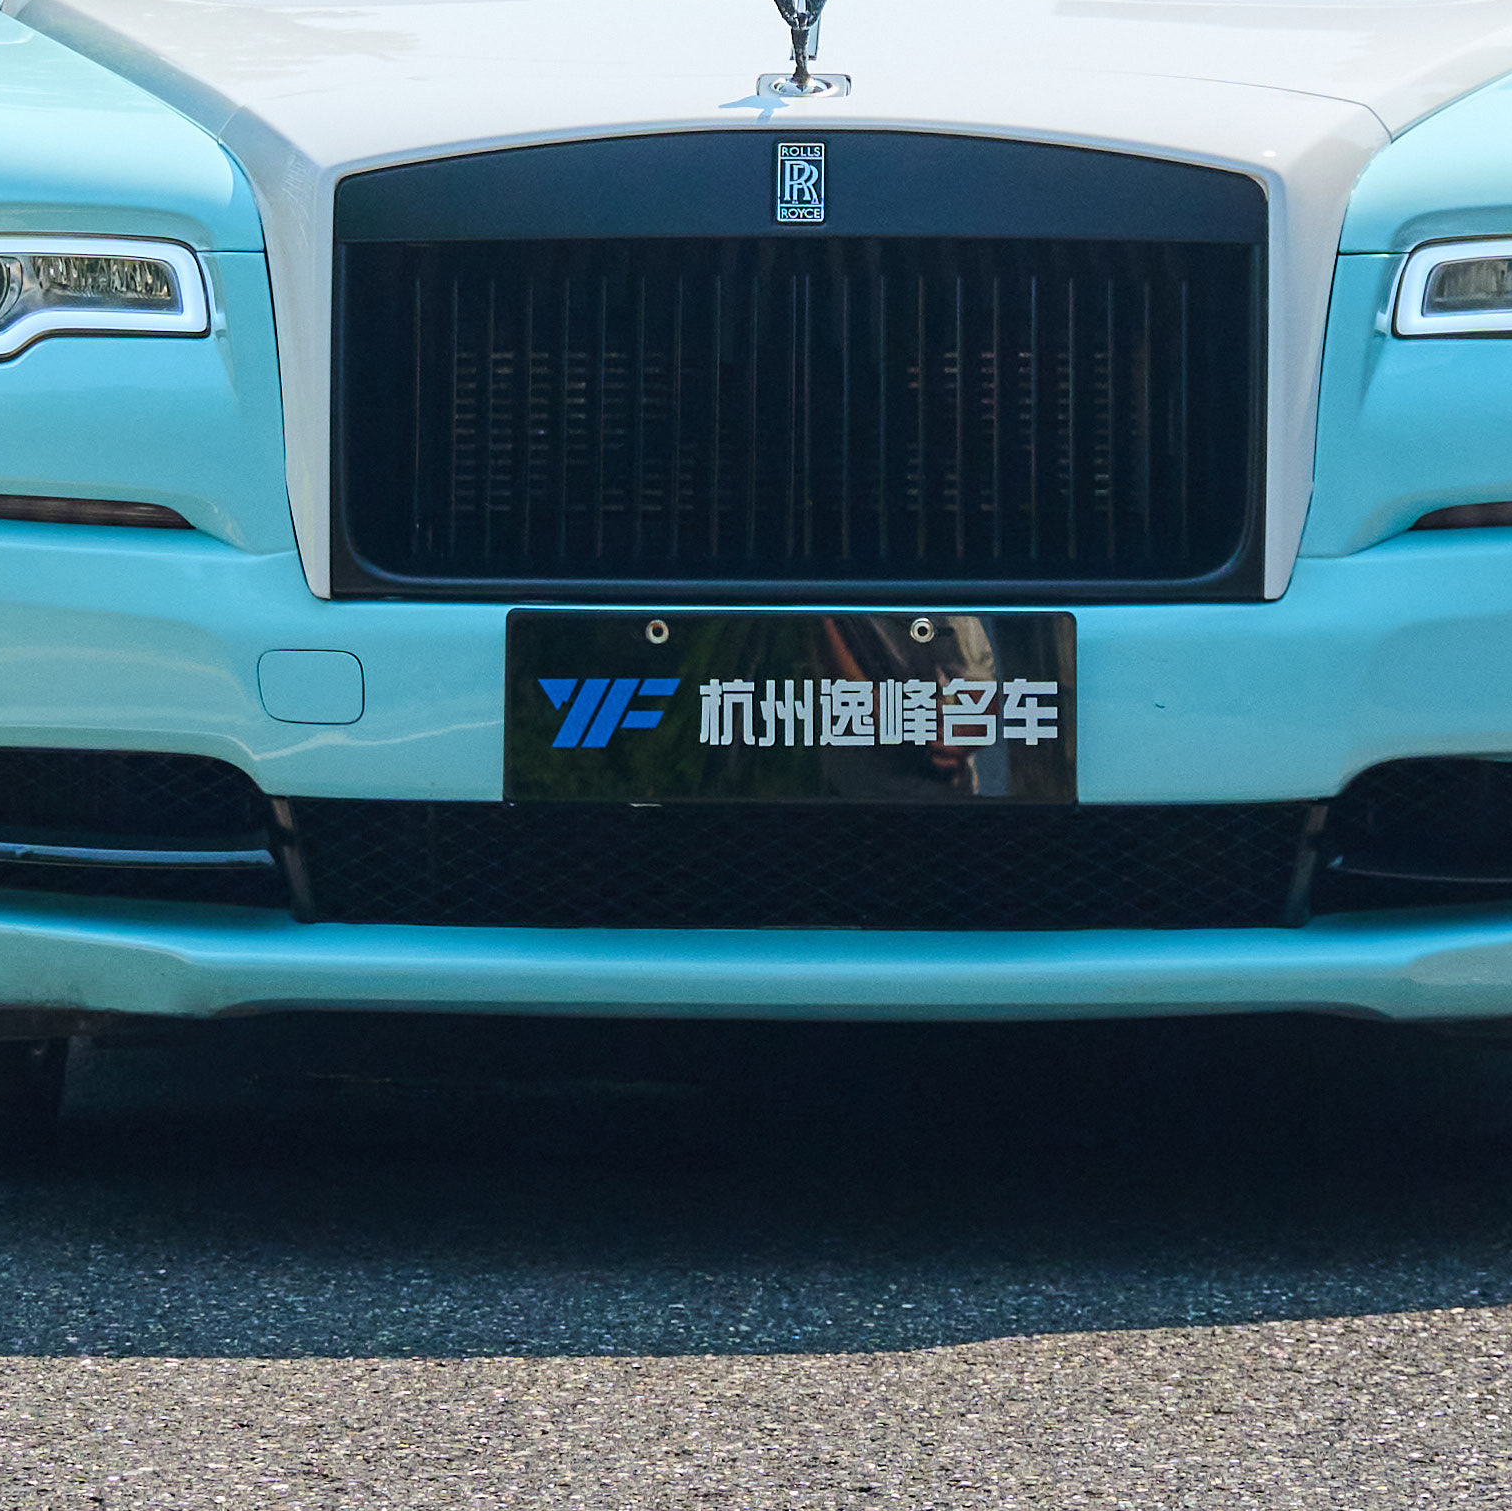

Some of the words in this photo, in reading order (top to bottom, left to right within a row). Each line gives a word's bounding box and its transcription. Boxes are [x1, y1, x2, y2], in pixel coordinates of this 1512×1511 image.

[781, 146, 821, 157] ROLLS
[783, 160, 820, 205] RR
[781, 208, 821, 219] ROYCE
[699, 677, 1059, 747] 杭州逸峰名车
